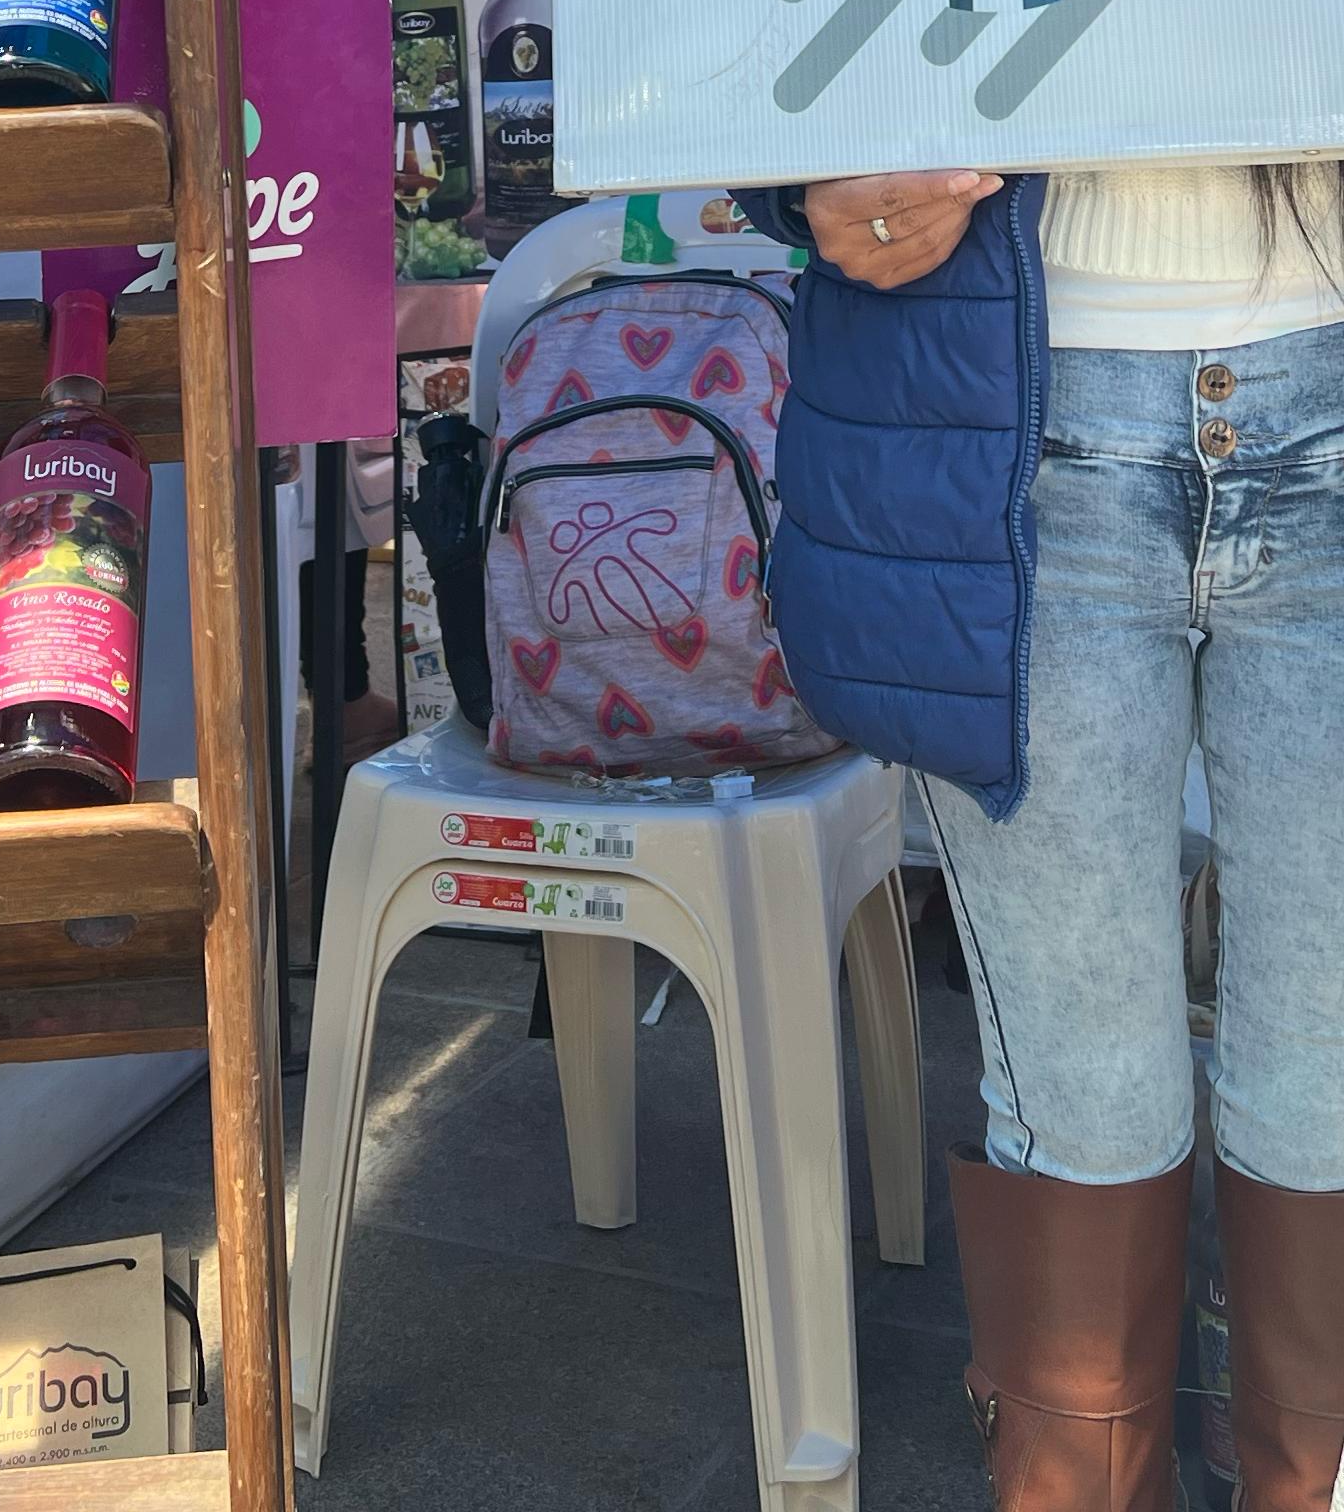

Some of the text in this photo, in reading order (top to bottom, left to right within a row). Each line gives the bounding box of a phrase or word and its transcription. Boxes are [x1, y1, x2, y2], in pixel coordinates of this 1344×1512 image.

[501, 129, 554, 145] Luriba
[24, 454, 117, 497] Luribay
[10, 591, 110, 614] Vino Rosado
[61, 1420, 77, 1433] de
[82, 1416, 119, 1429] altura
[30, 1455, 36, 1463] a
[40, 1448, 70, 1462] 2.900
